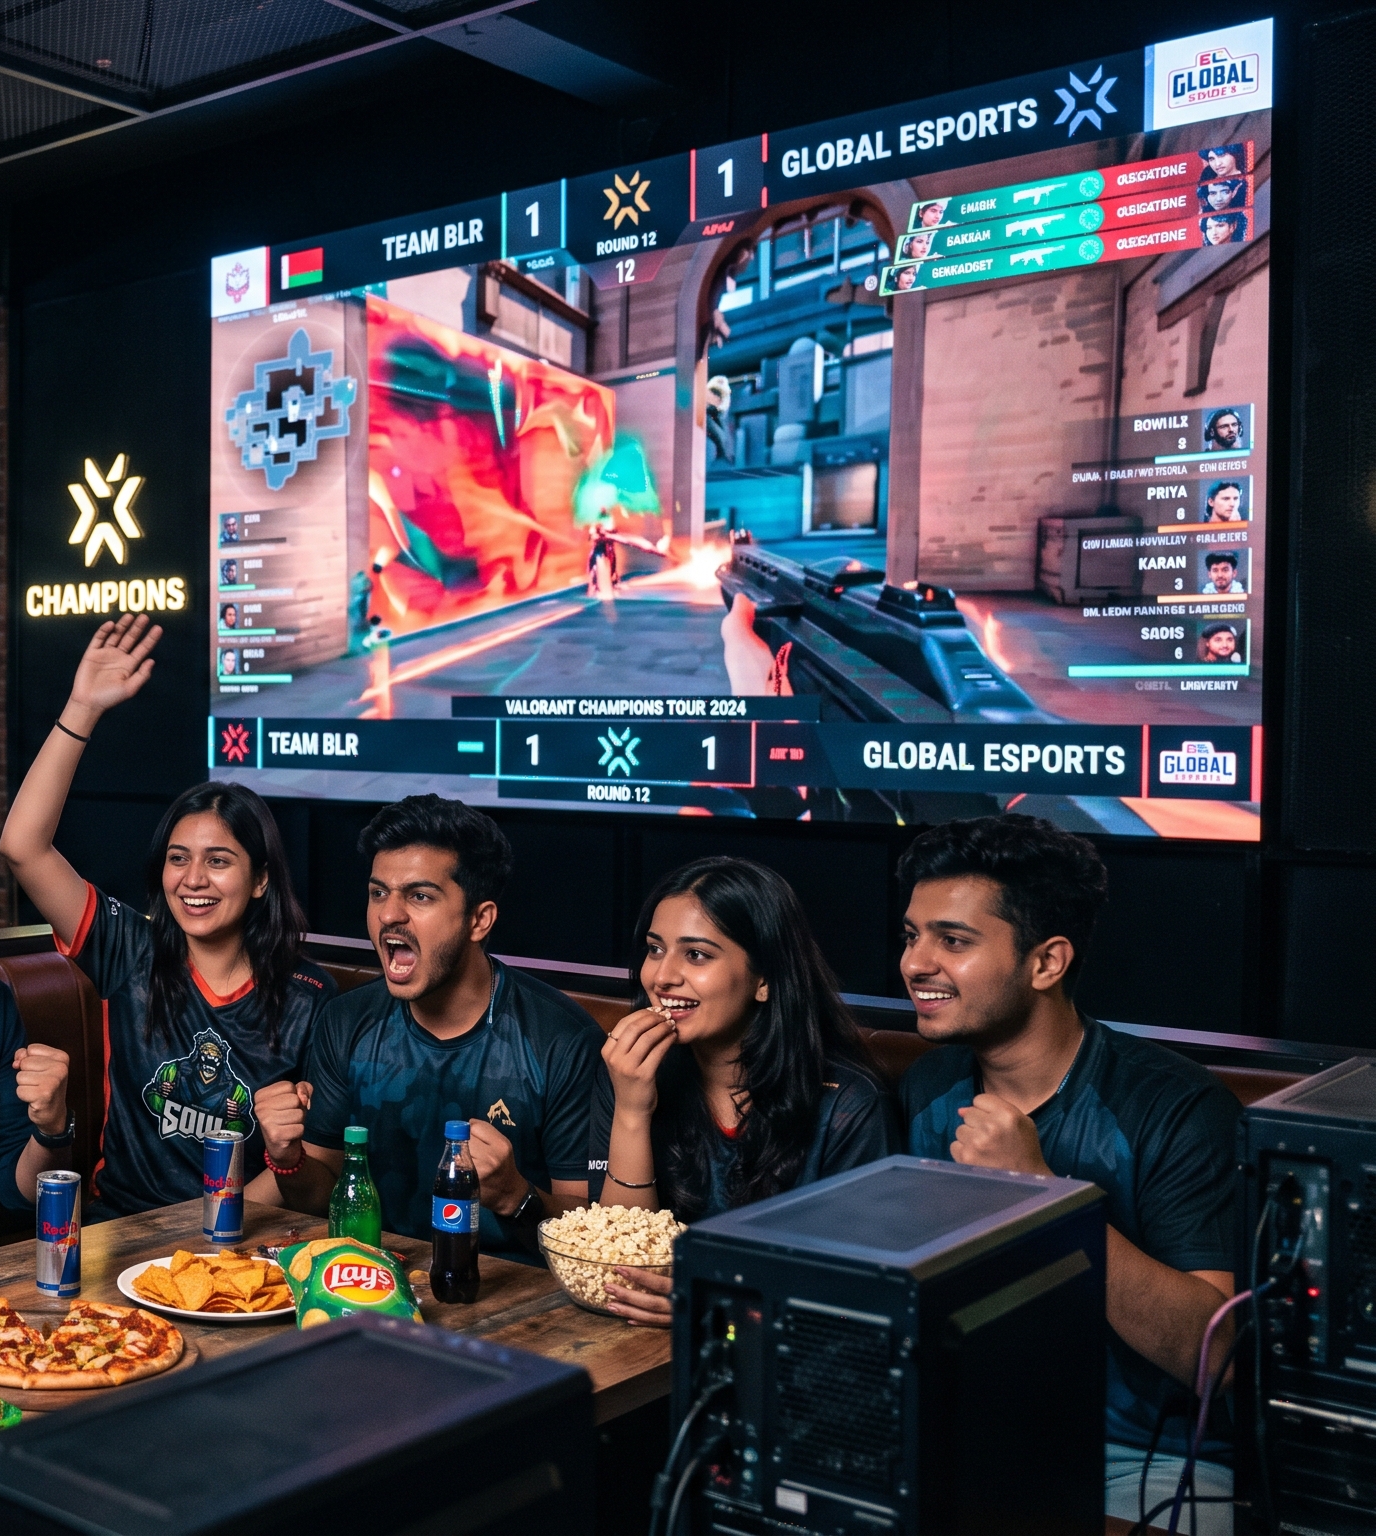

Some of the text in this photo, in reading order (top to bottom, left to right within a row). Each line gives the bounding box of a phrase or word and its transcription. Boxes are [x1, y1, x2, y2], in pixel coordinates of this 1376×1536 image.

[1172, 59, 1255, 98] GLOBAL
[781, 98, 1038, 179] GLOBAL ESPORTS
[717, 158, 734, 198] 1
[525, 201, 540, 237] 1
[382, 218, 484, 262] TEAM BLR
[596, 231, 657, 256] ROUND 12
[615, 258, 635, 284] 12
[1147, 485, 1188, 500] PRIYA
[1138, 556, 1187, 571] KARAN
[25, 577, 186, 618] CHAMPIONS
[1174, 578, 1183, 591] 3
[505, 698, 746, 717] VALORANT CHAMPIONS TOUR 2024
[268, 731, 359, 758] TEAM BLR
[525, 733, 540, 767] 1
[701, 735, 716, 771] 1
[862, 740, 1126, 776] GLOBAL ESPORTS
[1164, 755, 1233, 776] GLOBAL
[587, 784, 650, 803] ROUND 12
